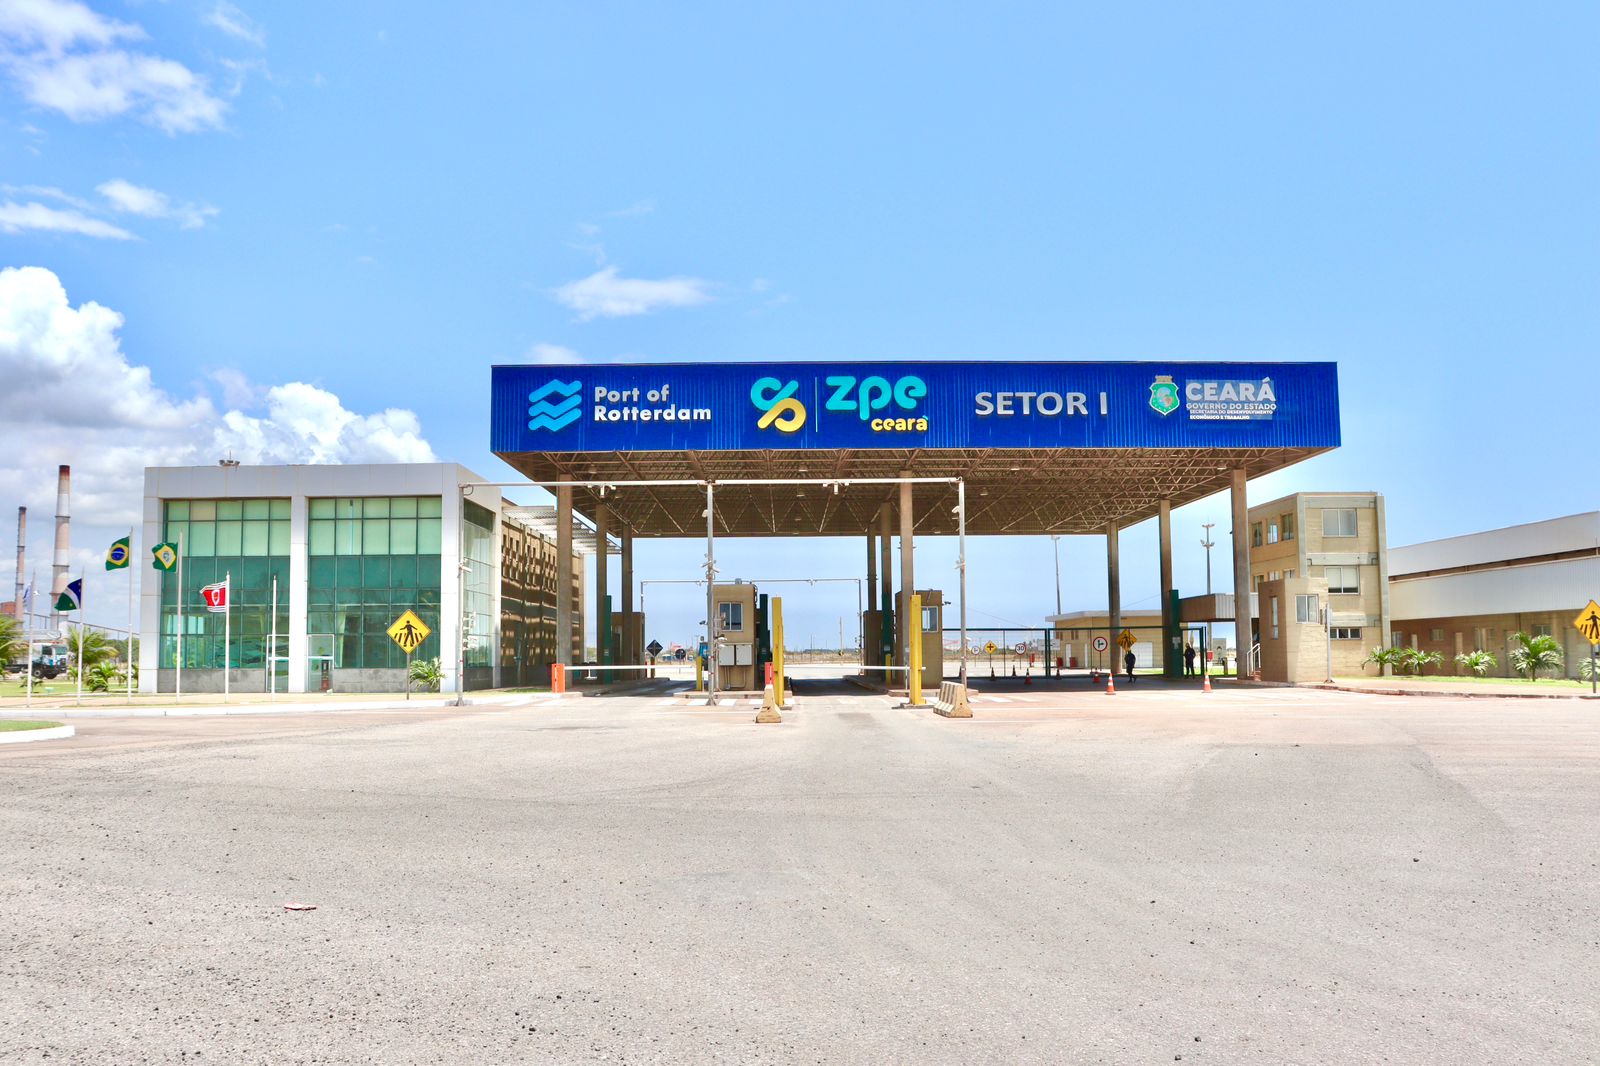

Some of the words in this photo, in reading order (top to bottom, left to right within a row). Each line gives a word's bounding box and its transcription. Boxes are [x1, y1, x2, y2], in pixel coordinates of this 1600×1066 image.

[594, 386, 640, 403] Port
[646, 384, 670, 403] of
[1185, 376, 1276, 402] CEARÁ
[594, 403, 712, 421] Rotterdam
[975, 391, 1089, 416] SETOR
[1099, 391, 1108, 415] I
